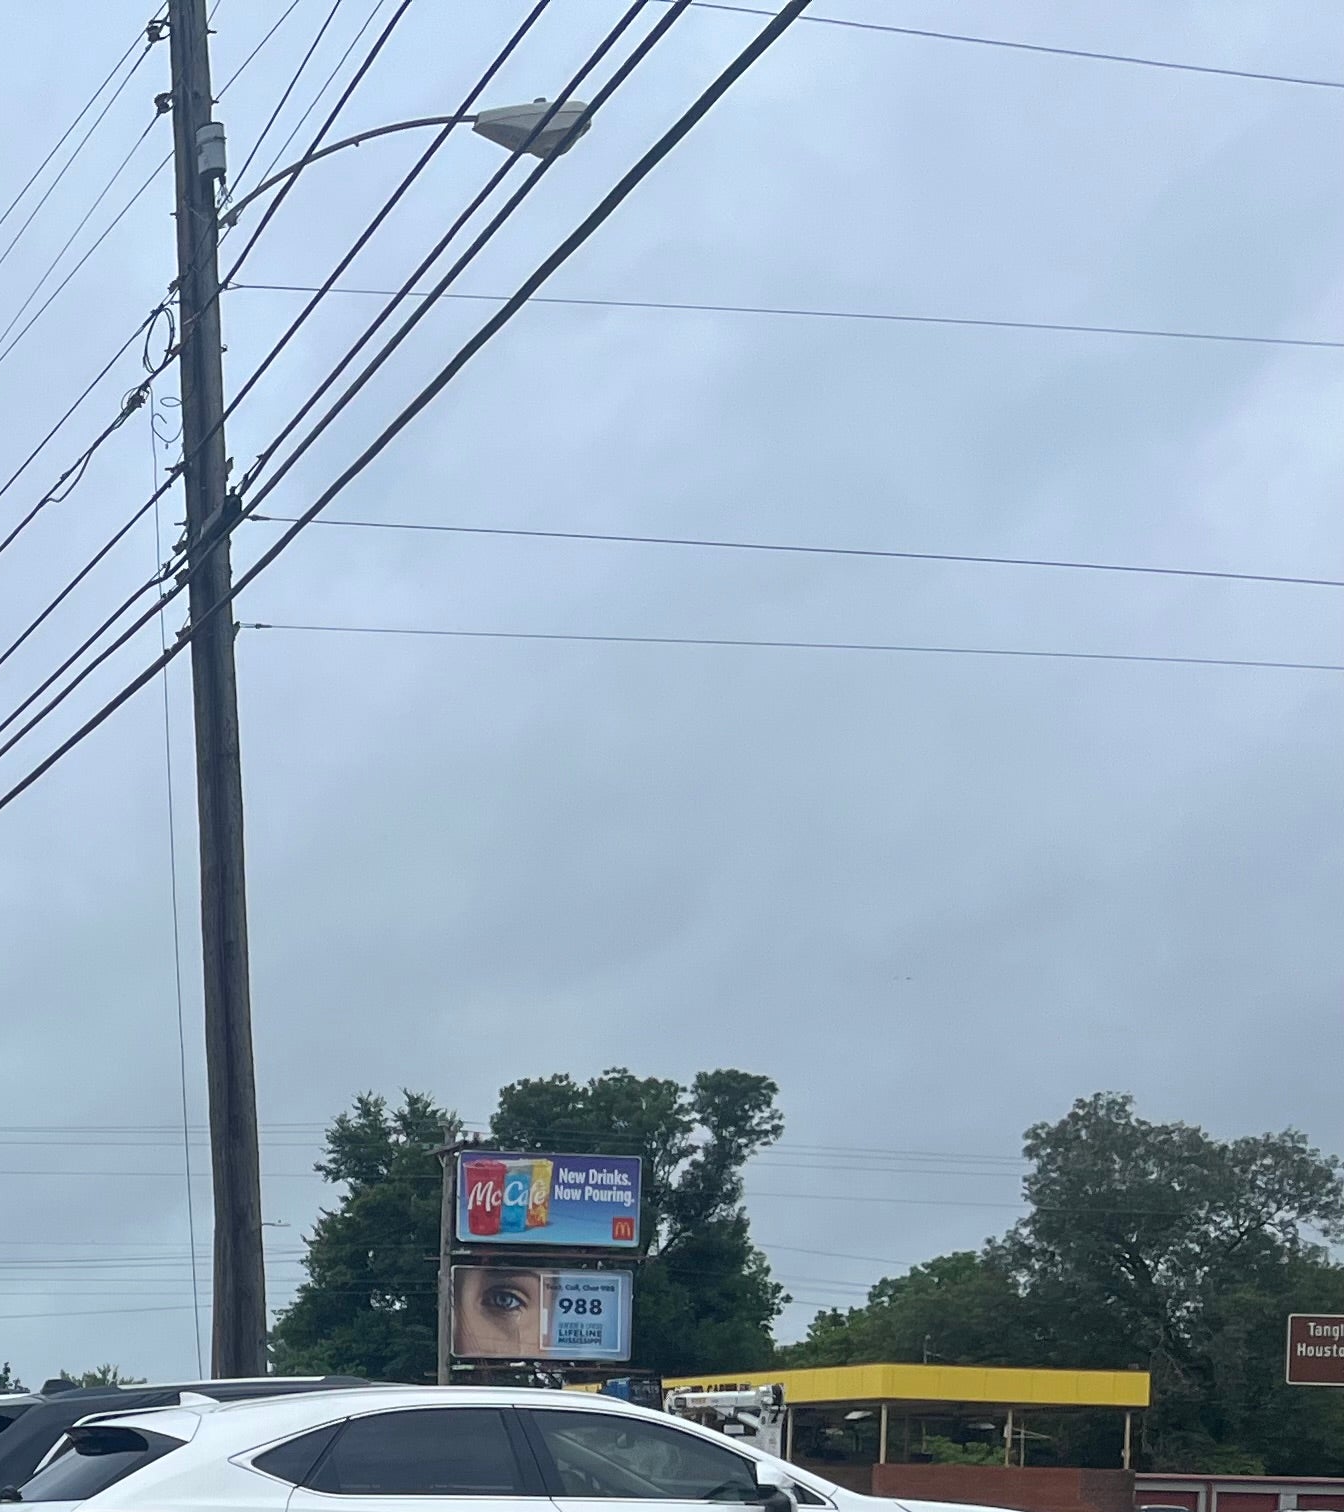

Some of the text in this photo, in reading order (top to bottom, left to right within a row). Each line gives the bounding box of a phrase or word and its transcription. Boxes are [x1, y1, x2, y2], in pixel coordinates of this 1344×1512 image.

[559, 1168, 632, 1186] New Drinks.
[554, 1185, 635, 1207] Now Pouring.
[558, 1298, 602, 1315] 988
[558, 1329, 602, 1337] LIFELINE
